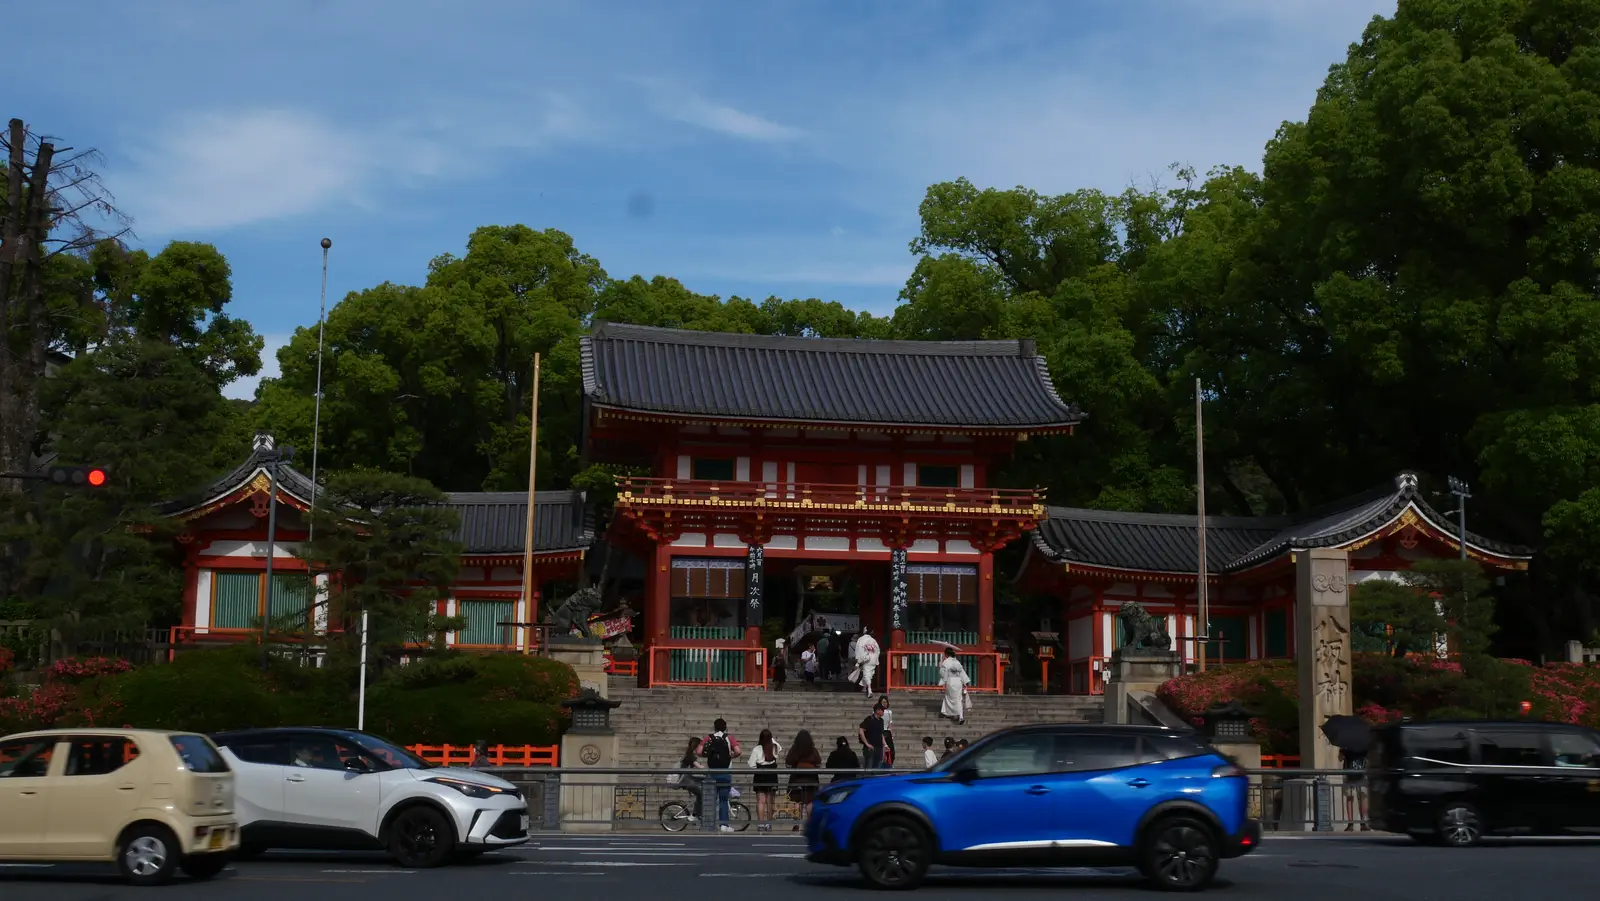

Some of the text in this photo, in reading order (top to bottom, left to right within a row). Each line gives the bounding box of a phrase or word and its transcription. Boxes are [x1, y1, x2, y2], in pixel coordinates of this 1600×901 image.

[750, 572, 761, 609] 月次祭
[1313, 615, 1349, 741] 八坂神
